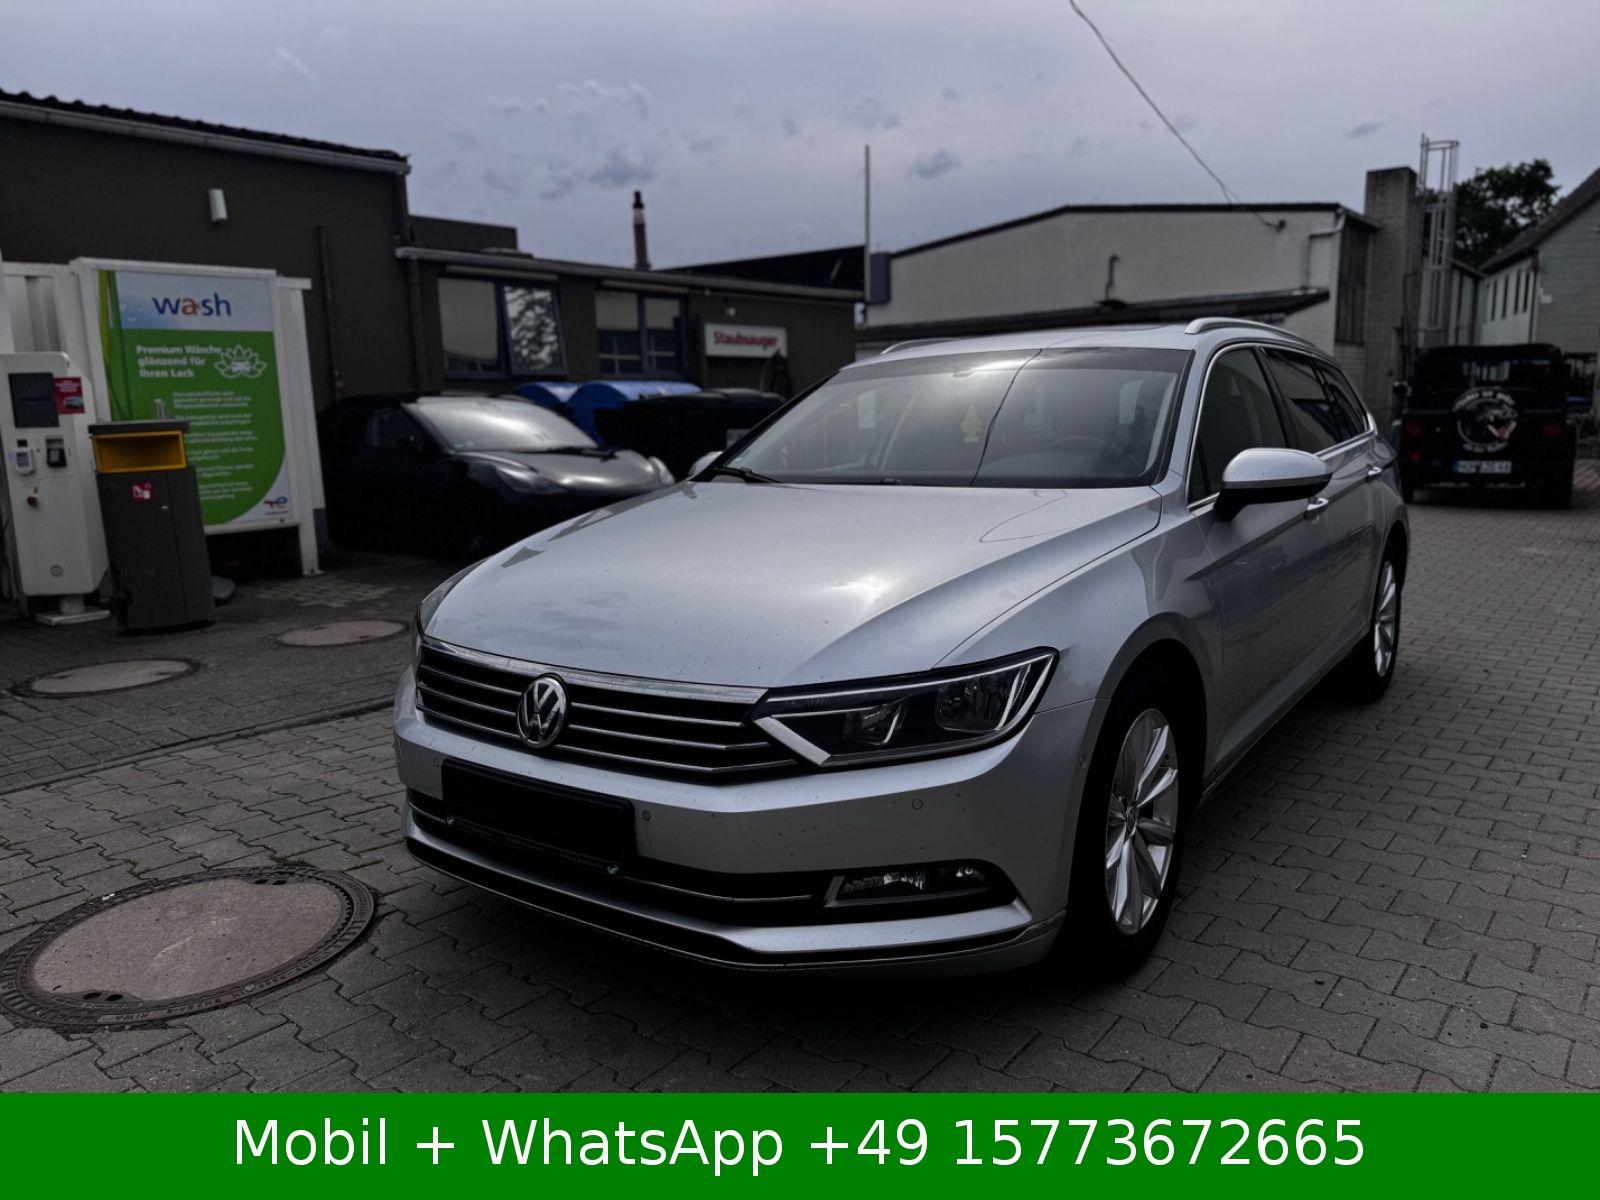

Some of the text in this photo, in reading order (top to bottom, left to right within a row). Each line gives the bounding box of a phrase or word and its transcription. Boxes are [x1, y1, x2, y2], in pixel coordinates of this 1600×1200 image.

[152, 292, 232, 317] wash
[713, 331, 778, 350] Staubsauger
[136, 345, 183, 354] Premium
[138, 356, 206, 367] glänzend für
[139, 368, 195, 378] Ihren Lack
